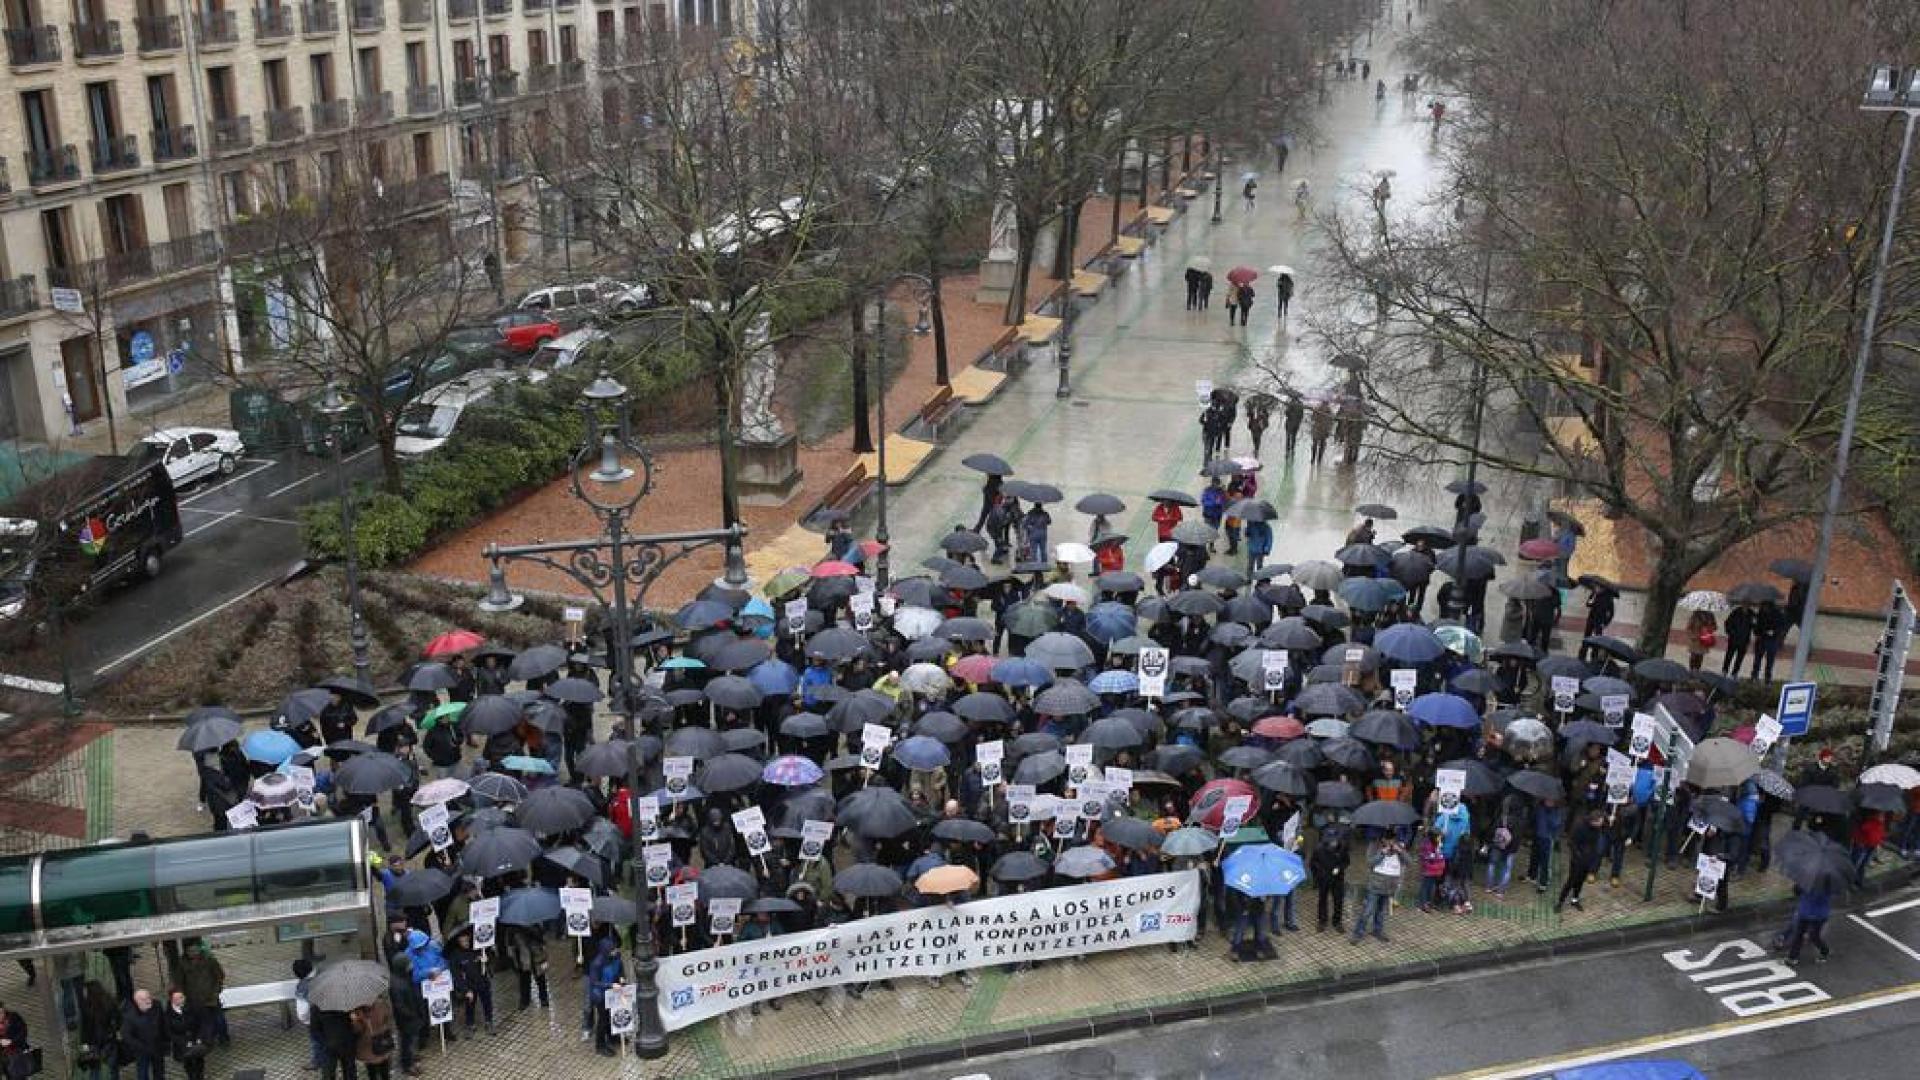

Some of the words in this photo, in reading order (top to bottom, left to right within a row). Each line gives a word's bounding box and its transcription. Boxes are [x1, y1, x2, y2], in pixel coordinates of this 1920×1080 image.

[816, 937, 841, 951] DE
[857, 926, 894, 944] LAS
[907, 910, 1019, 932] PALABRAS
[1029, 907, 1041, 922] A
[1052, 899, 1090, 918] LOS
[1099, 885, 1177, 910] HECHOS
[847, 932, 959, 959] SOLUCION
[974, 912, 1124, 942] KONPONBIDEA
[728, 964, 842, 999] GOBERNUA
[855, 948, 967, 973] HITZETIK
[982, 927, 1132, 957] EKINTZETARA
[1662, 938, 1832, 1017] BUS
